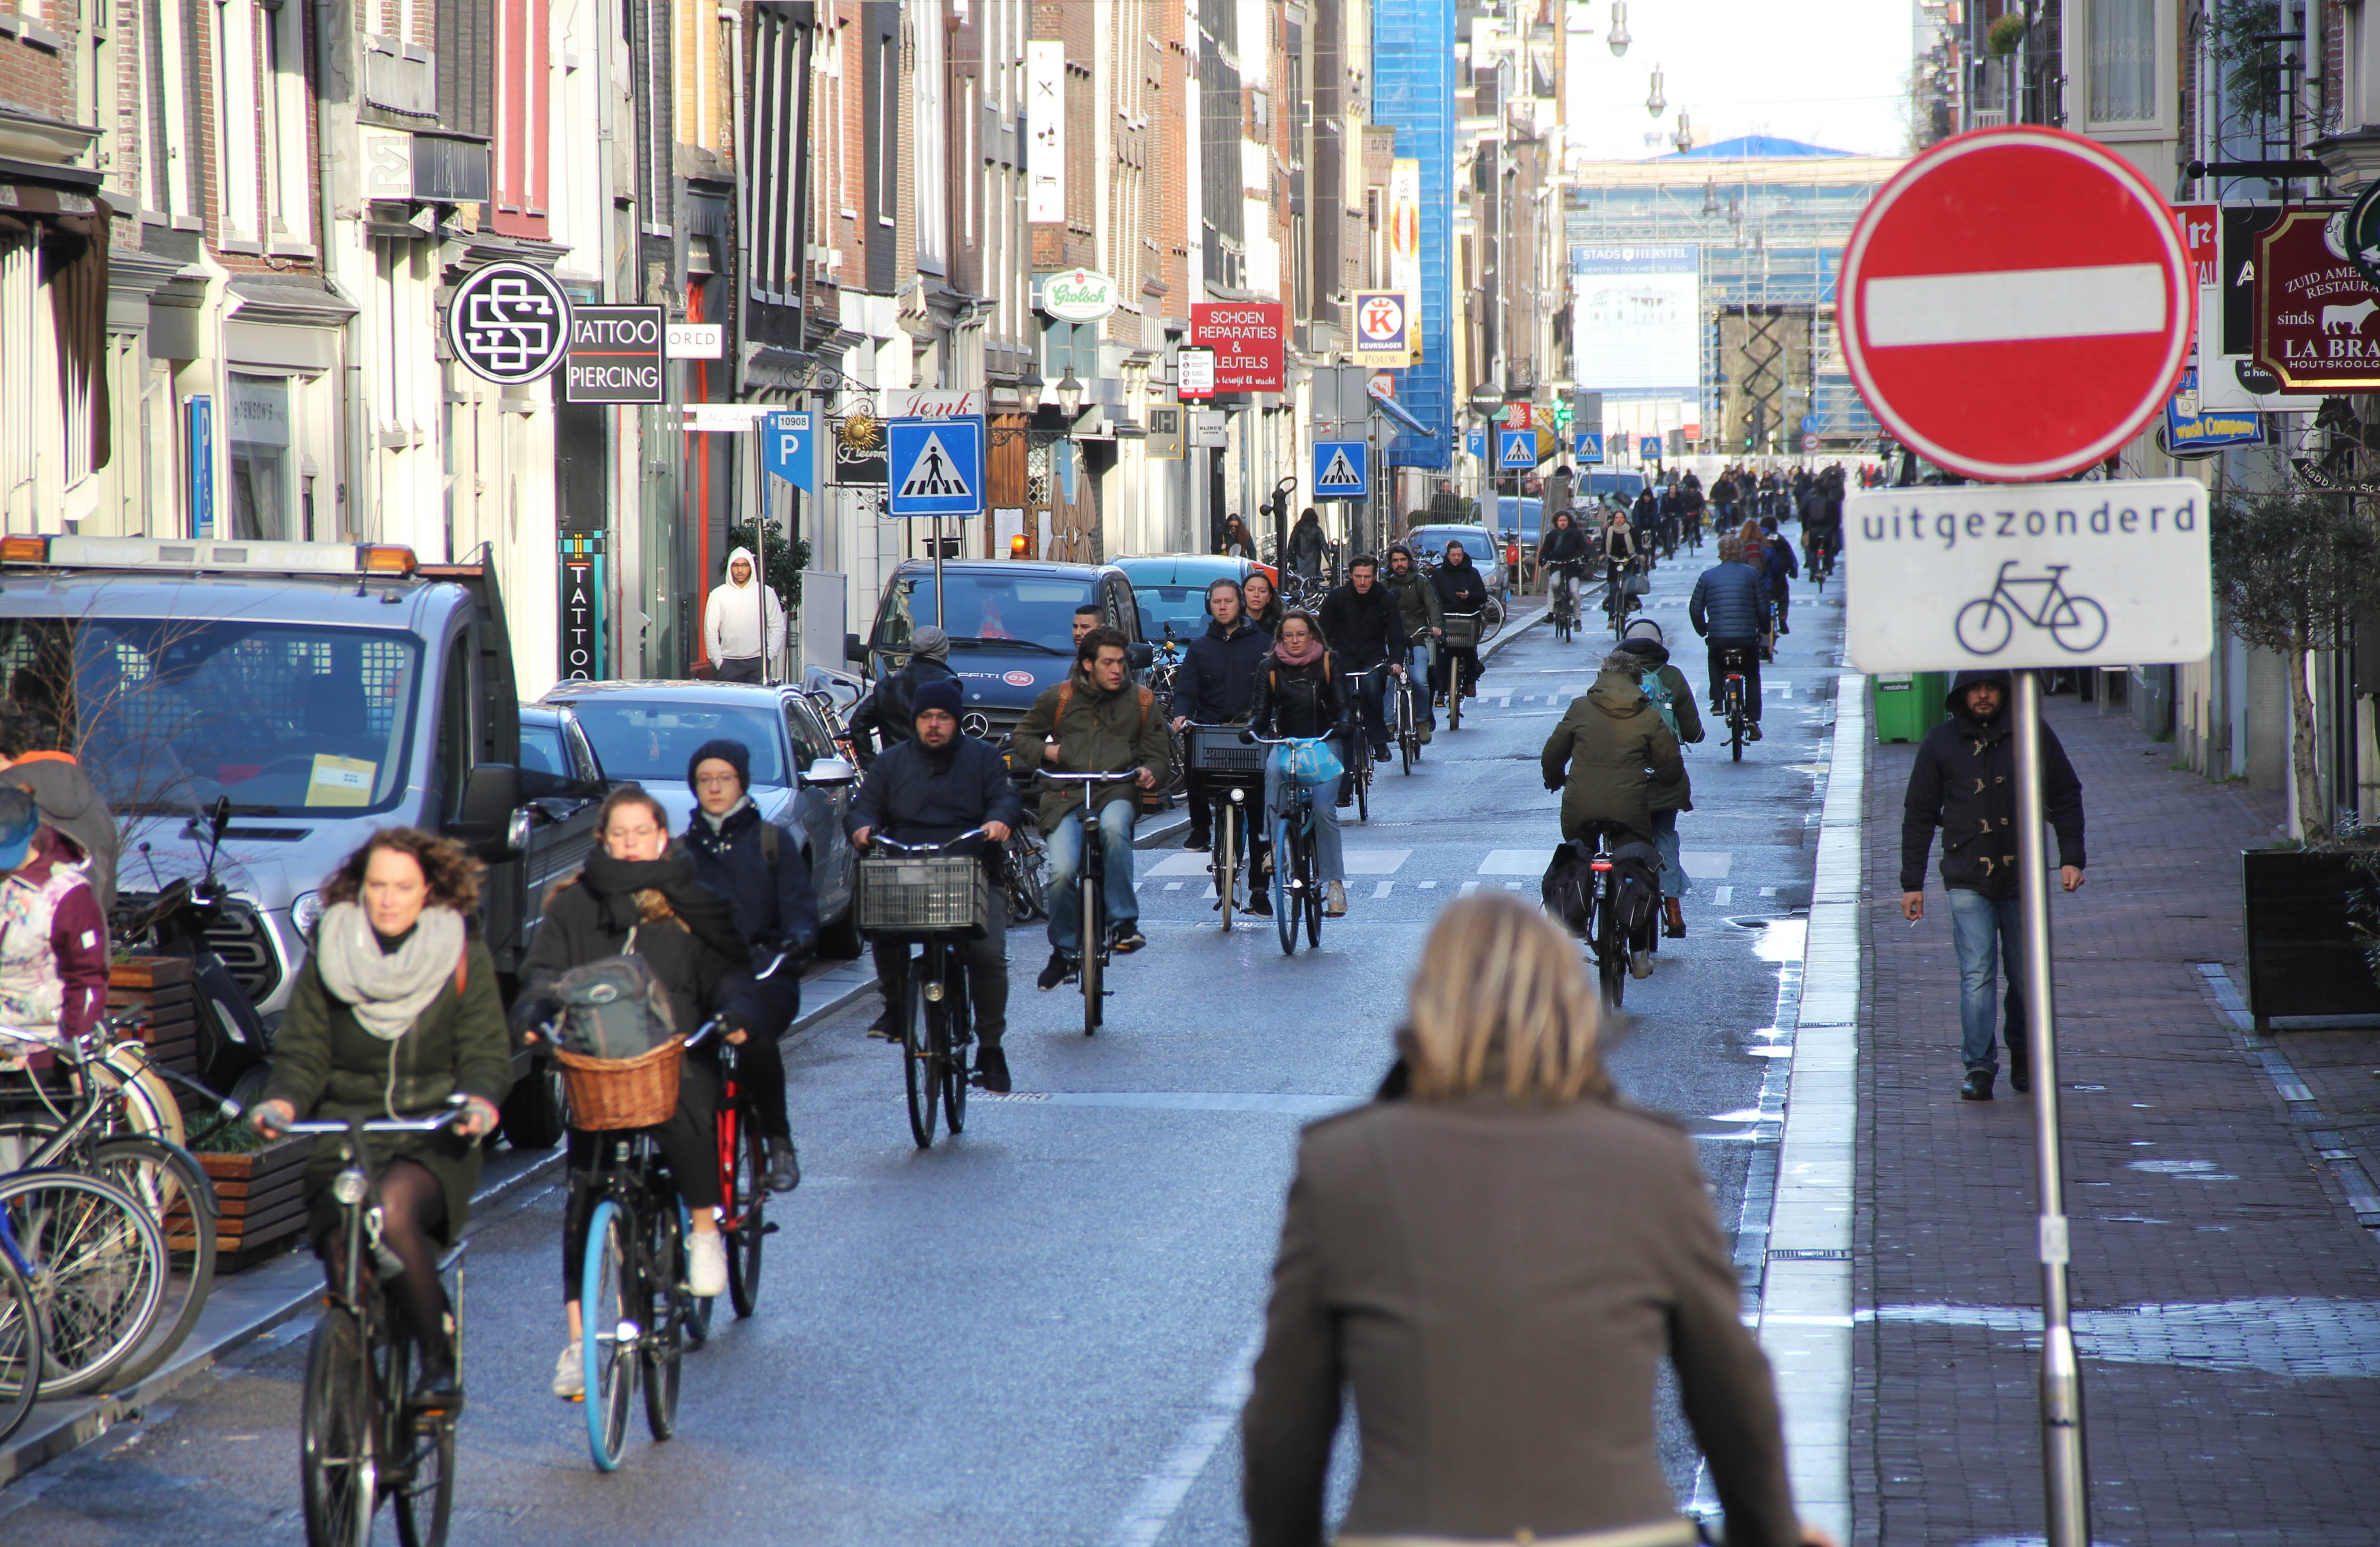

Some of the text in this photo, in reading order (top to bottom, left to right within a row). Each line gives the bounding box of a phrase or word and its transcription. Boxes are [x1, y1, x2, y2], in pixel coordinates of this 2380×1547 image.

[1583, 247, 1688, 260] STADS HERSTEL
[2285, 272, 2320, 293] ZUID
[1052, 284, 1107, 306] Grolsch
[1210, 311, 1265, 324] SCHOEN
[1367, 310, 1395, 333] K
[2277, 311, 2315, 325] sinds
[574, 319, 658, 344] TATTOO
[1198, 326, 1277, 339] REPARATIES
[1232, 341, 1242, 353] &
[2284, 339, 2319, 358] LA
[1214, 356, 1269, 369] LEUTELS
[570, 366, 658, 388] PIERCING
[1255, 376, 1276, 385] wacht
[780, 417, 807, 426] 10908
[780, 434, 799, 465] P
[1472, 438, 1479, 450] P
[1863, 500, 2195, 550] uitgezonderd
